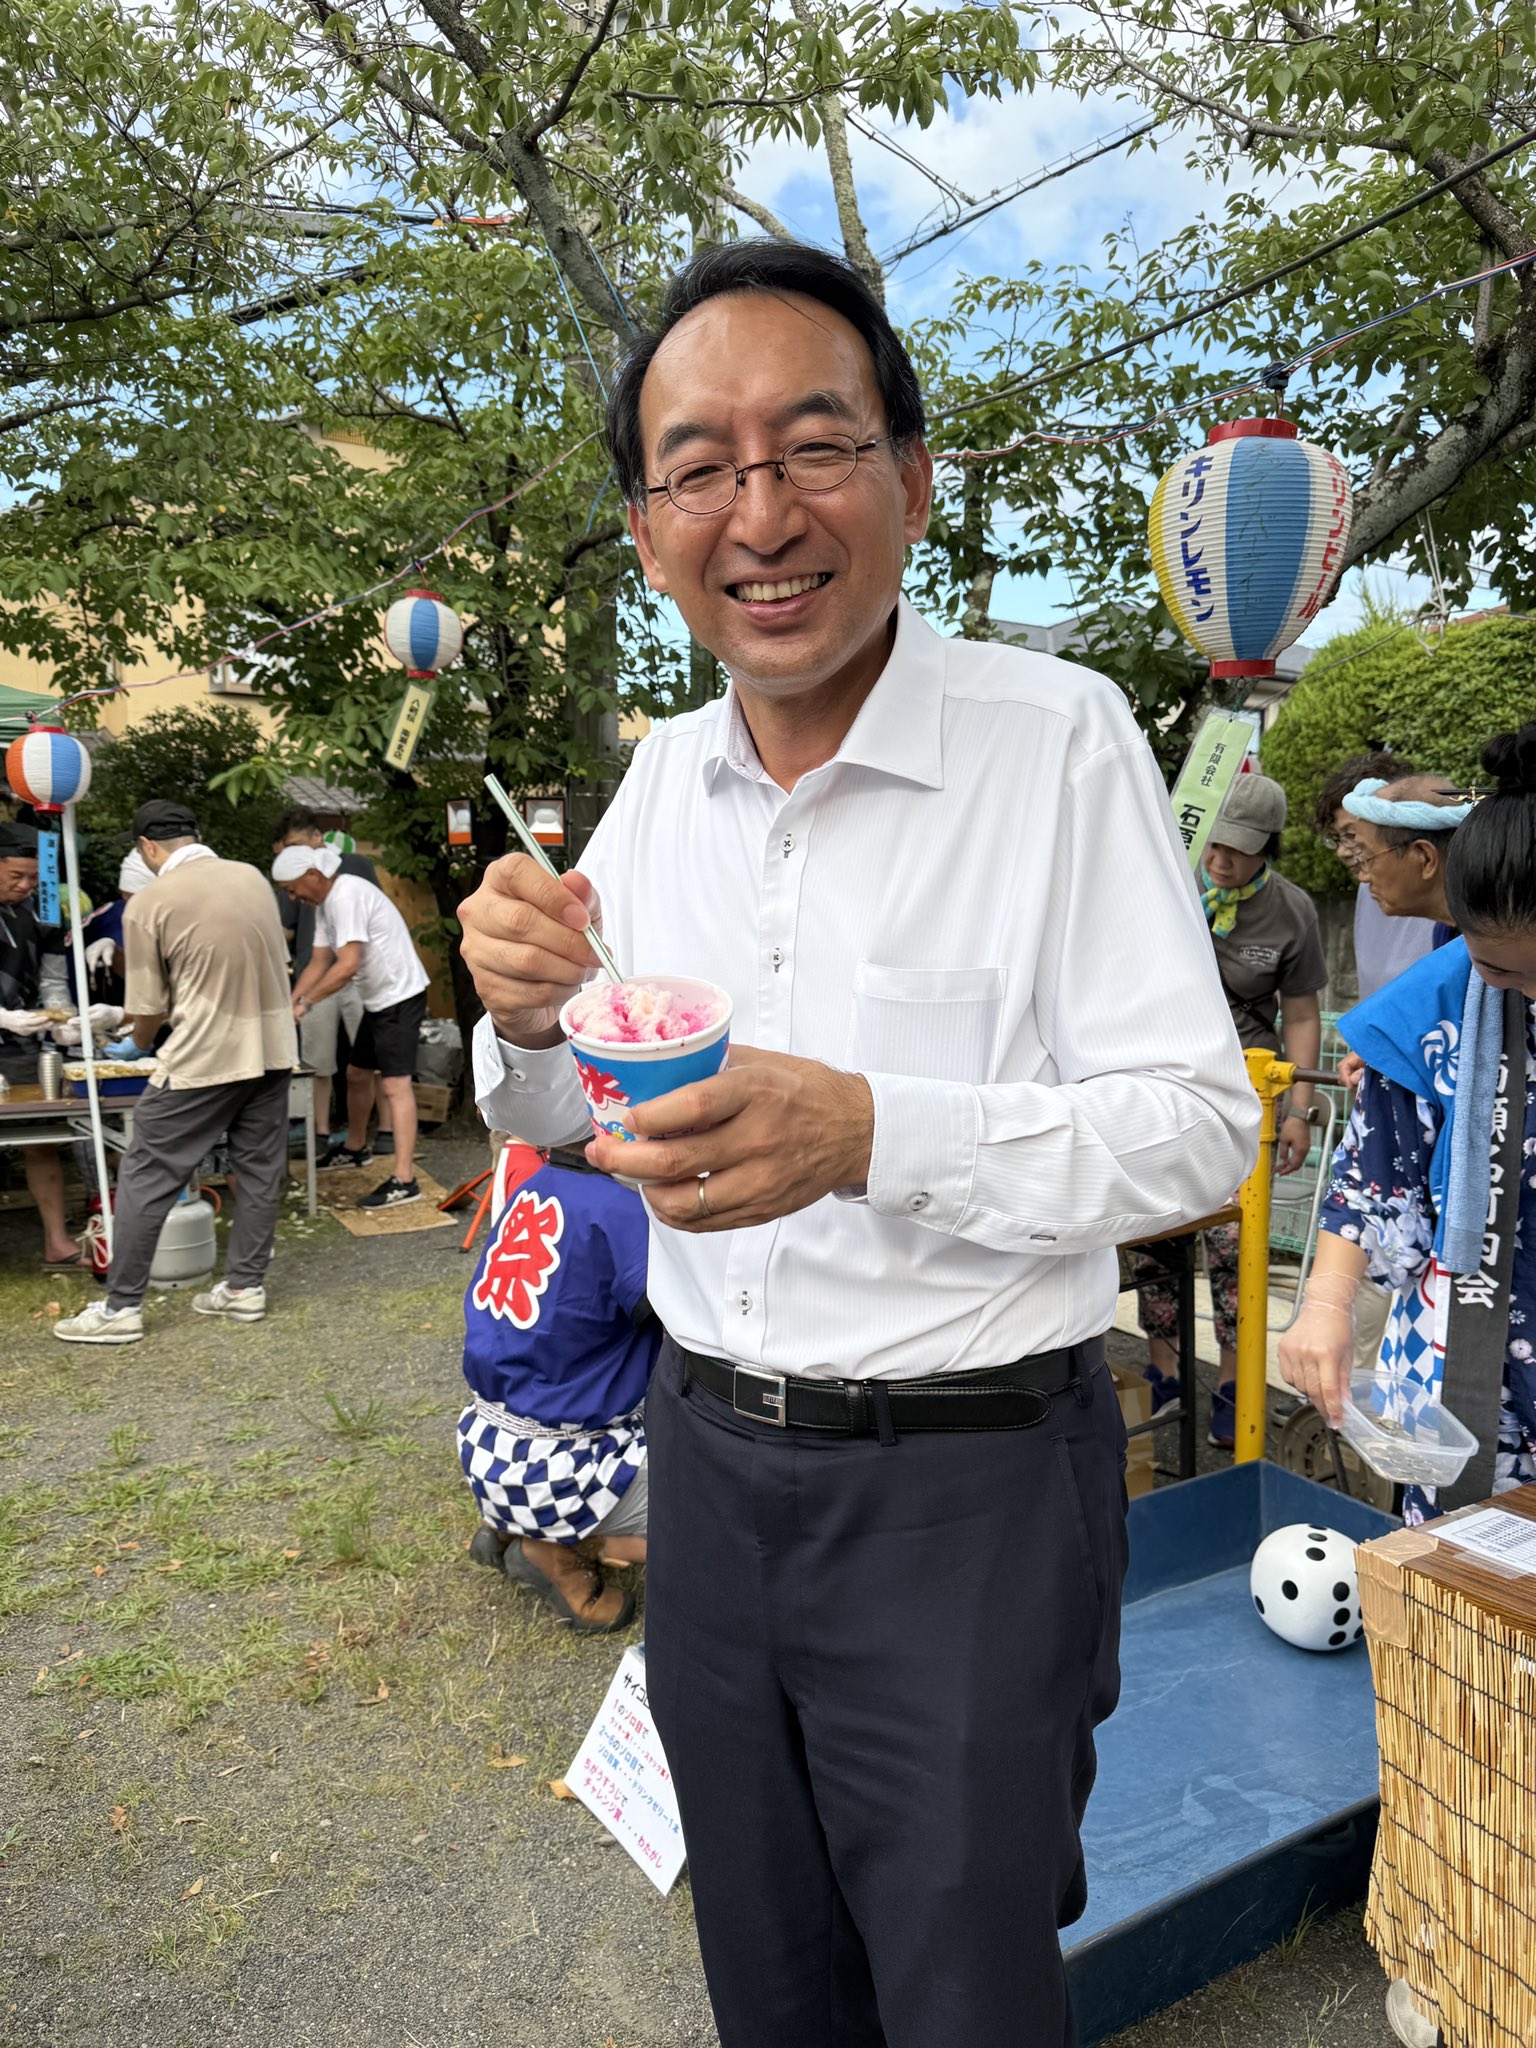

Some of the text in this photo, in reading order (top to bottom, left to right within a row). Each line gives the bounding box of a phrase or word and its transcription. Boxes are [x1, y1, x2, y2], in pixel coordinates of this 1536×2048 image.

[1179, 455, 1215, 623] キリンレモン
[1298, 451, 1346, 619] キリンビール
[1200, 742, 1227, 787] 有限会社
[474, 1192, 563, 1326] 祭
